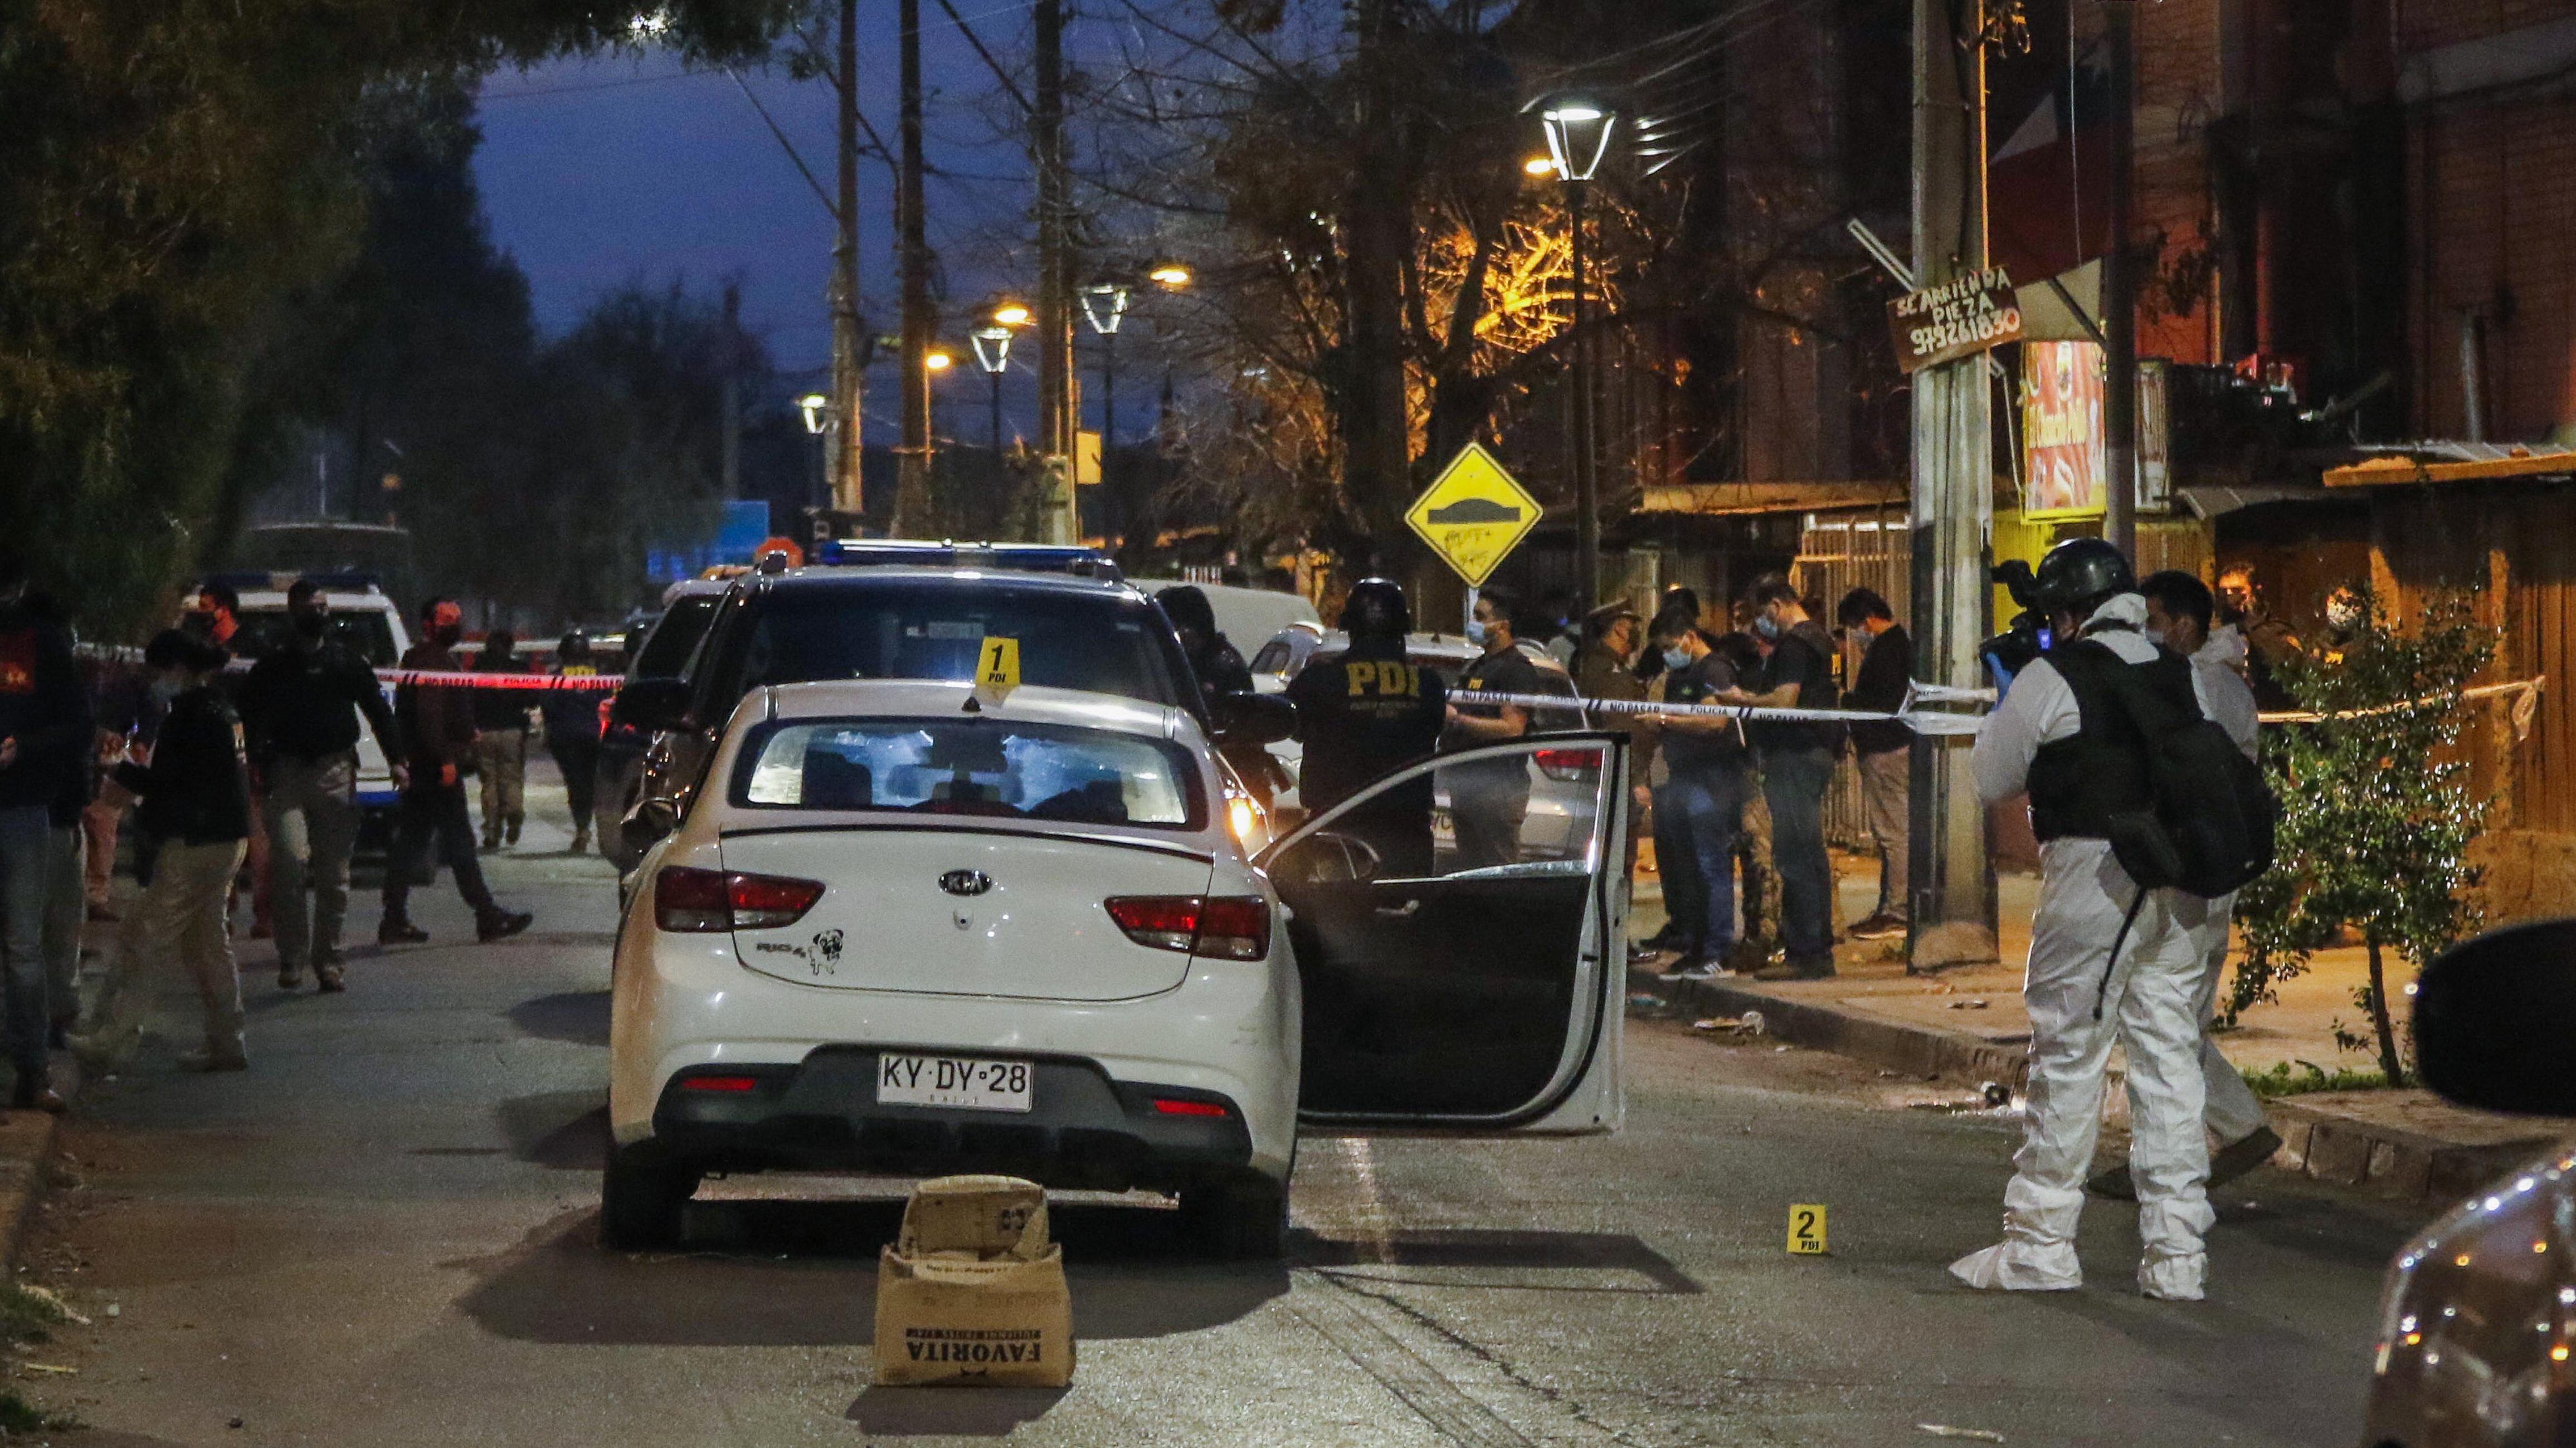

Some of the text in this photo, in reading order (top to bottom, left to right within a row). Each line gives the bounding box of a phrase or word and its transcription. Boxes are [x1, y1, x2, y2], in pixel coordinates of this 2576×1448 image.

[1932, 291, 1995, 327] PIEZA
[992, 643, 1003, 671] 1
[1347, 661, 1420, 696] PDI
[1690, 704, 1727, 715] POLICIA
[948, 874, 983, 891] KIA
[1797, 1211, 1815, 1238] 2
[1801, 1241, 1819, 1250] PDI
[906, 1342, 1040, 1362] FAVORITA
